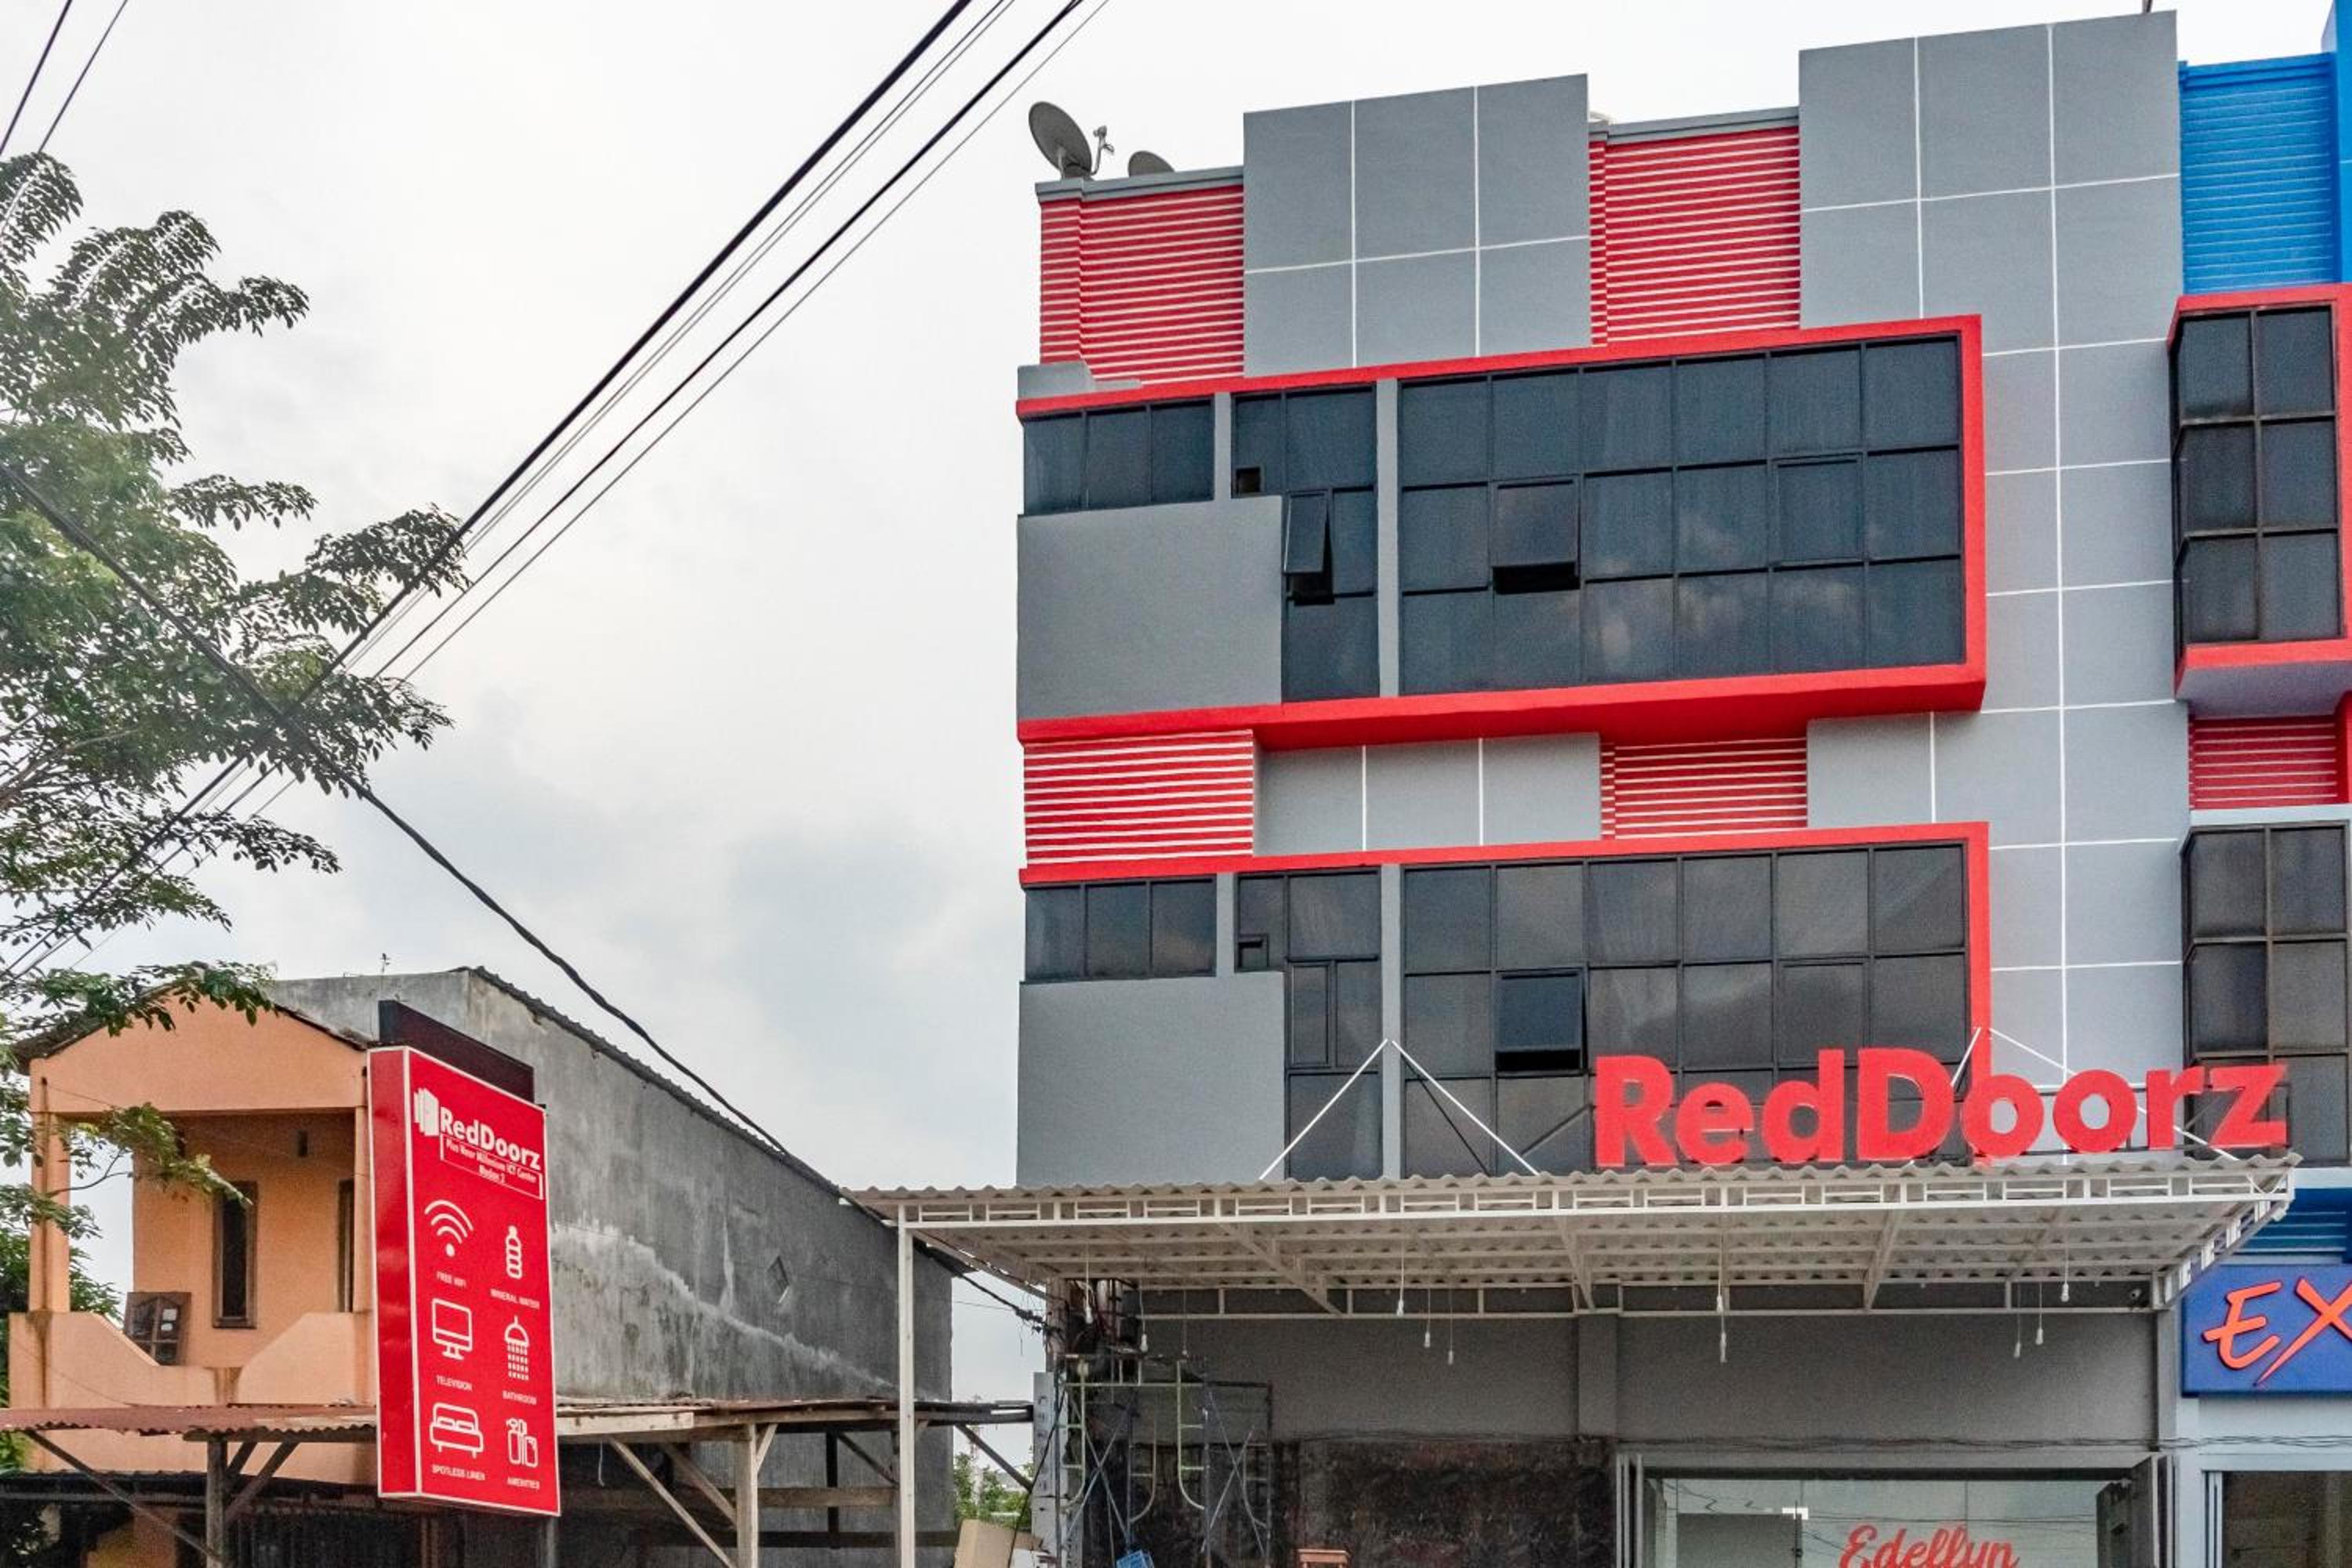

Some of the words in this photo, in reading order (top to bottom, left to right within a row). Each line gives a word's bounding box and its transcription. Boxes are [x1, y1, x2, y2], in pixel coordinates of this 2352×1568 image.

[1595, 1048, 2287, 1167] RedDoorz
[440, 1106, 541, 1171] RedDoorz
[436, 1271, 452, 1284] FREE
[436, 1374, 473, 1392] TELEVISION
[432, 1464, 466, 1479] SPOTLESS
[1839, 1523, 2020, 1568] Edellyn
